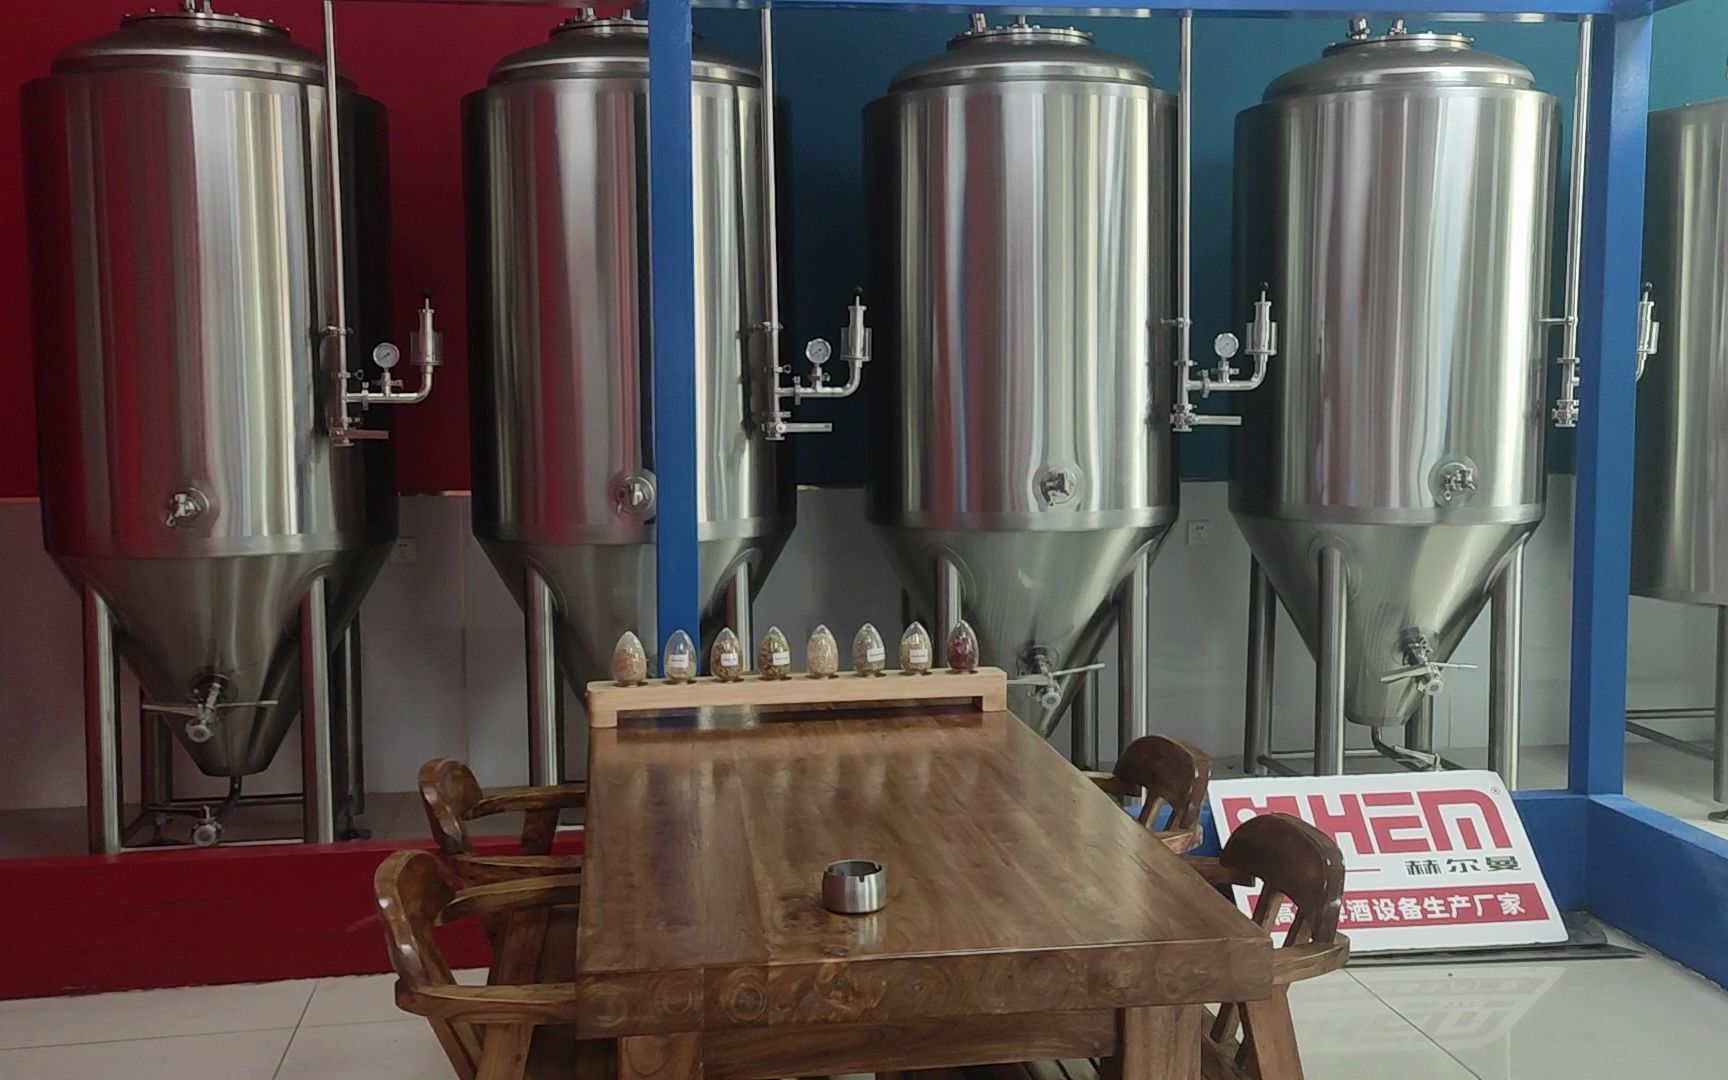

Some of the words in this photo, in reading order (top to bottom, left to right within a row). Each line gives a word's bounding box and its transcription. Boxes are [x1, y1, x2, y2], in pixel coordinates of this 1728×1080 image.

[1404, 855, 1522, 876] 赫尔曼
[1275, 892, 1526, 926] 高酒设备生产厂家
